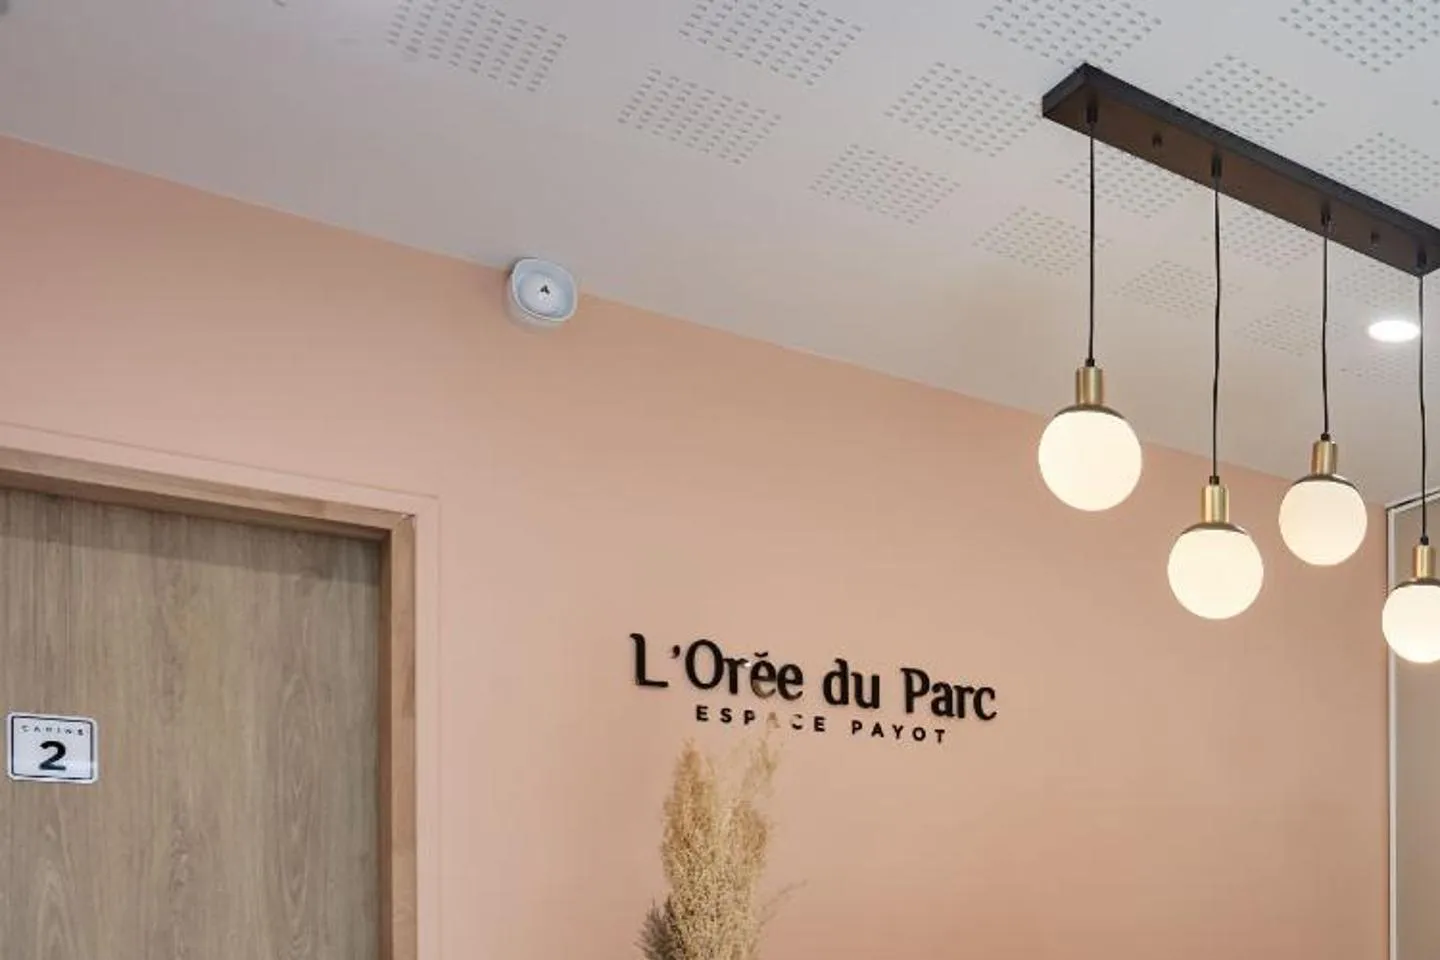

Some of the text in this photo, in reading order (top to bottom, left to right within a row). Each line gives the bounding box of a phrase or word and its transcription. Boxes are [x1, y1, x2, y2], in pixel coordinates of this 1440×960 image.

[630, 633, 998, 721] L'Orée du Parc
[852, 719, 946, 744] PAYOT
[39, 740, 67, 771] 2
